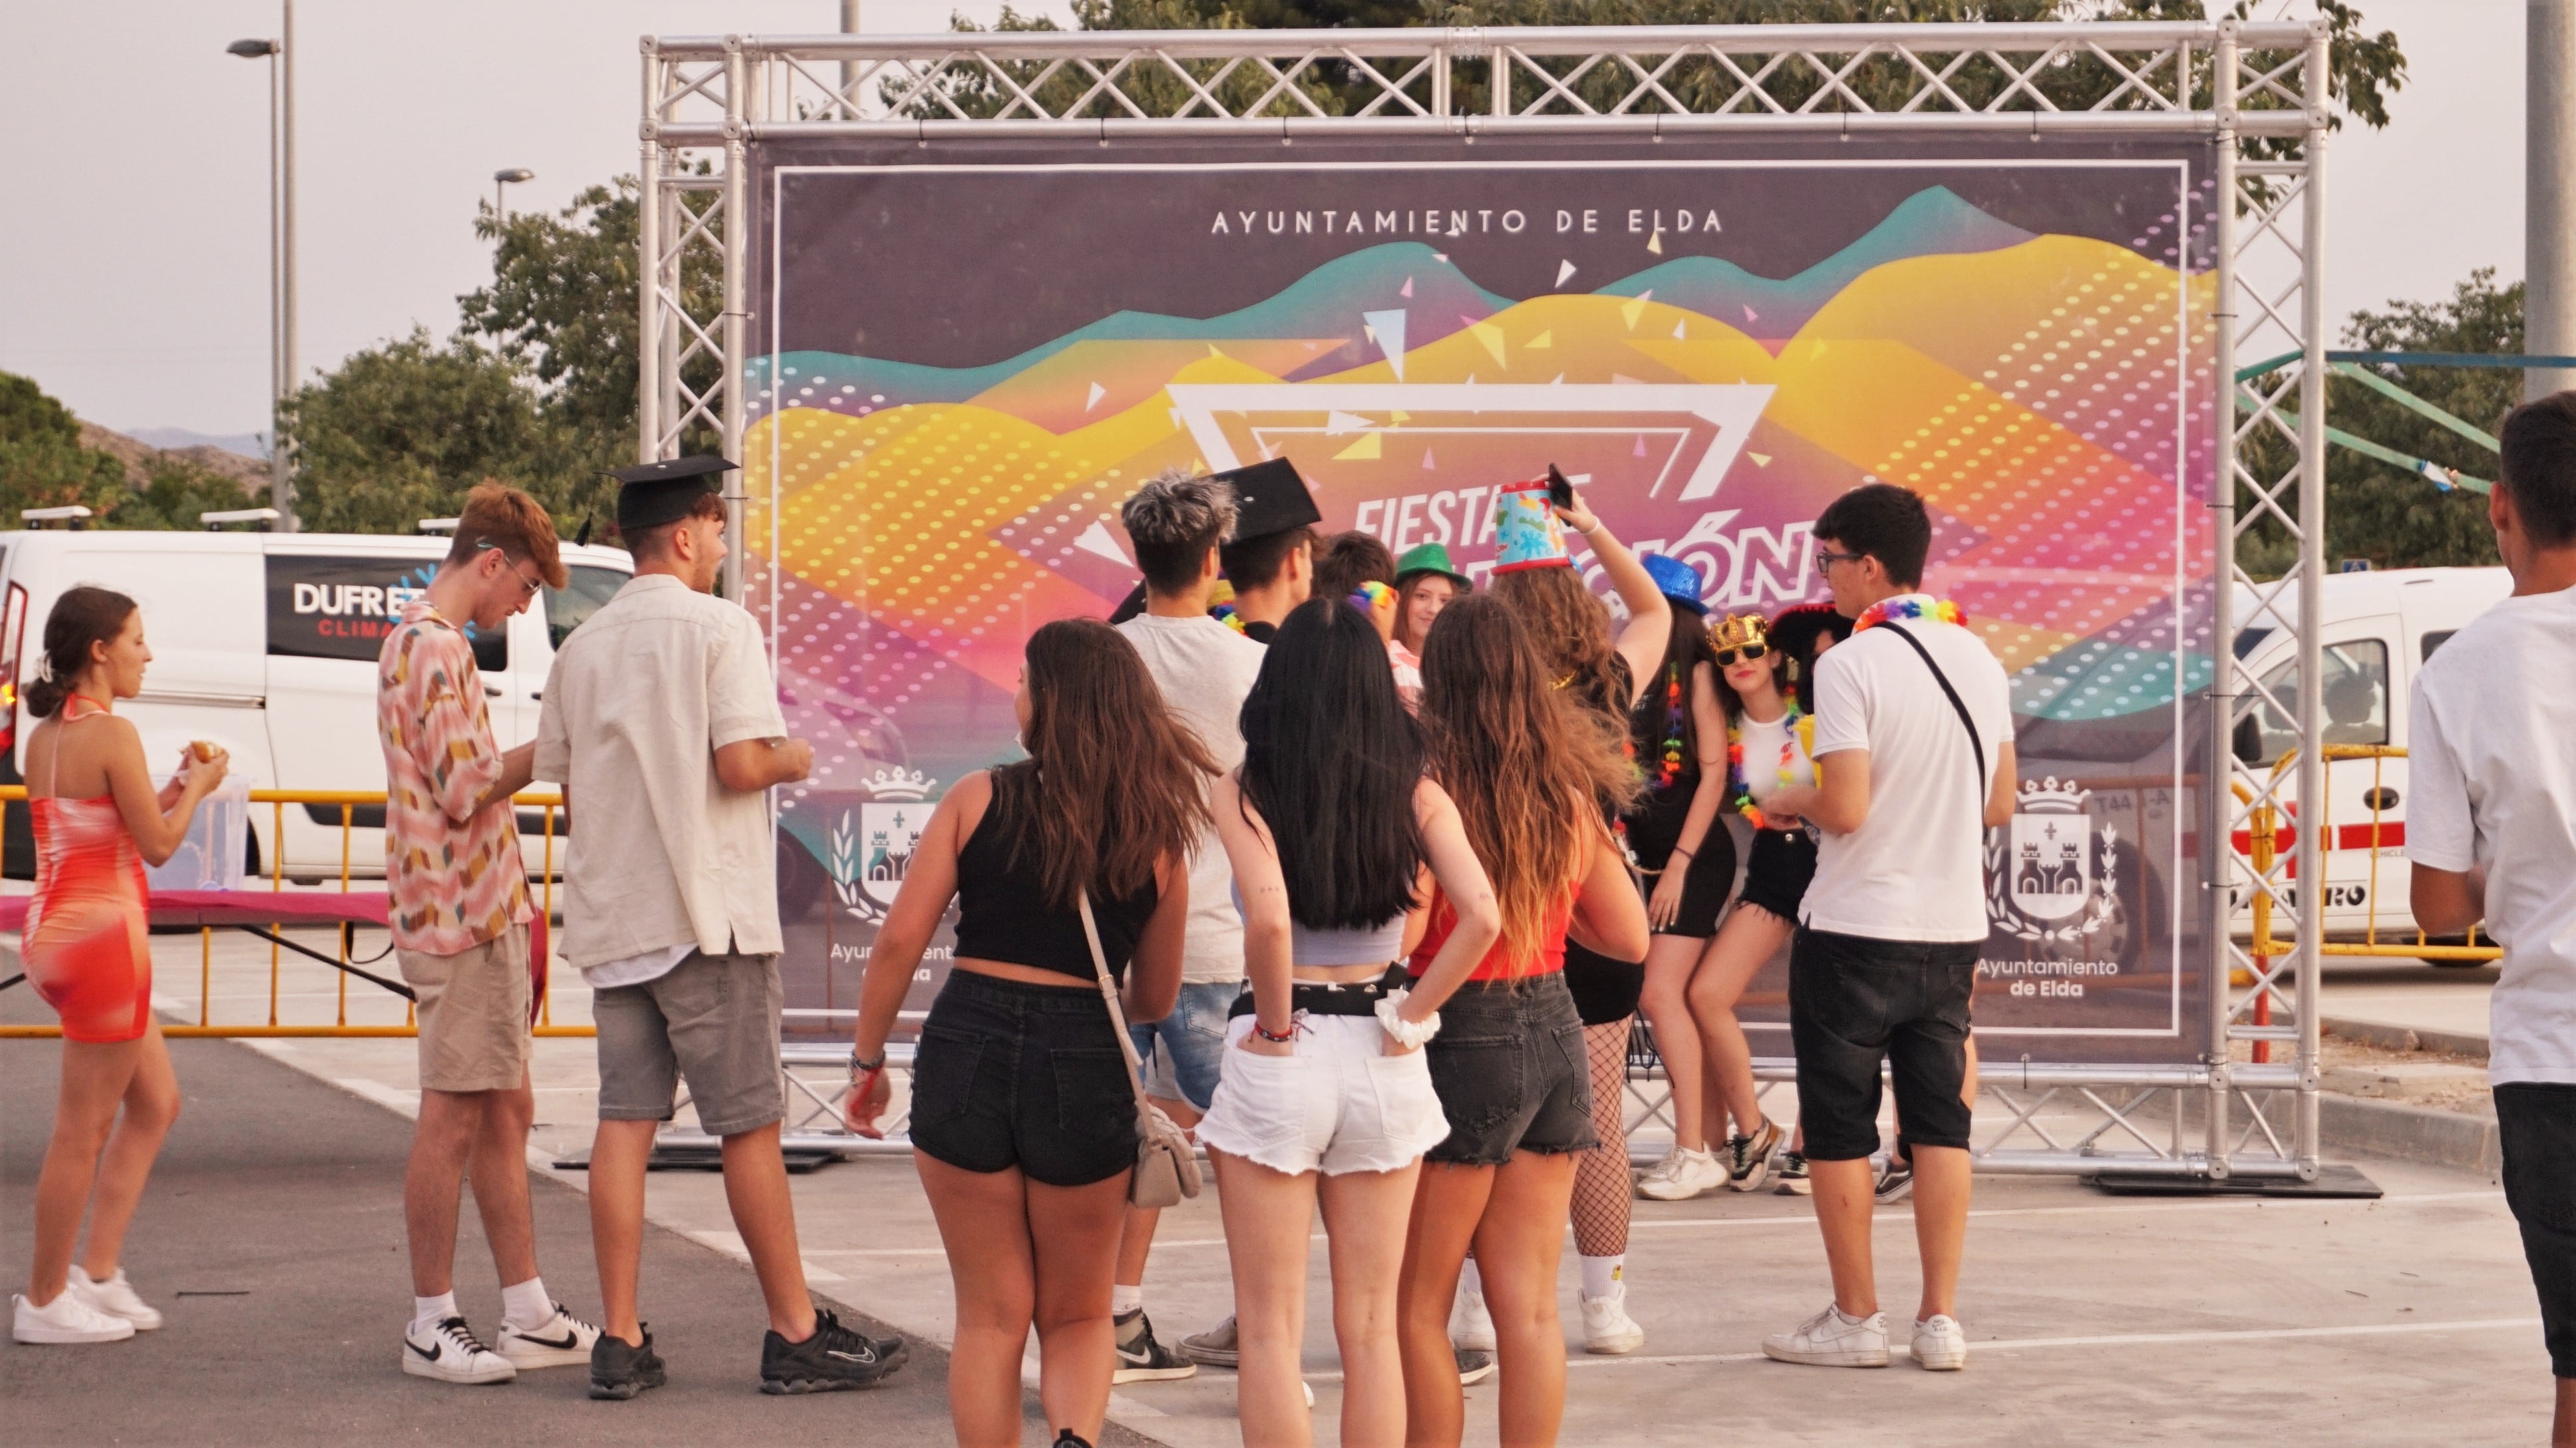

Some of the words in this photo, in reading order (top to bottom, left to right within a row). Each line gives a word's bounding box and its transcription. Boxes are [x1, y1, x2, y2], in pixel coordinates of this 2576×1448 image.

[1211, 210, 1527, 234] AYUNTAMIENTO
[1556, 209, 1597, 232] DE
[1628, 209, 1722, 232] ELDA
[1977, 958, 2118, 978] Ayuntamiento
[2010, 980, 2036, 996] de
[2040, 980, 2083, 997] Elda
